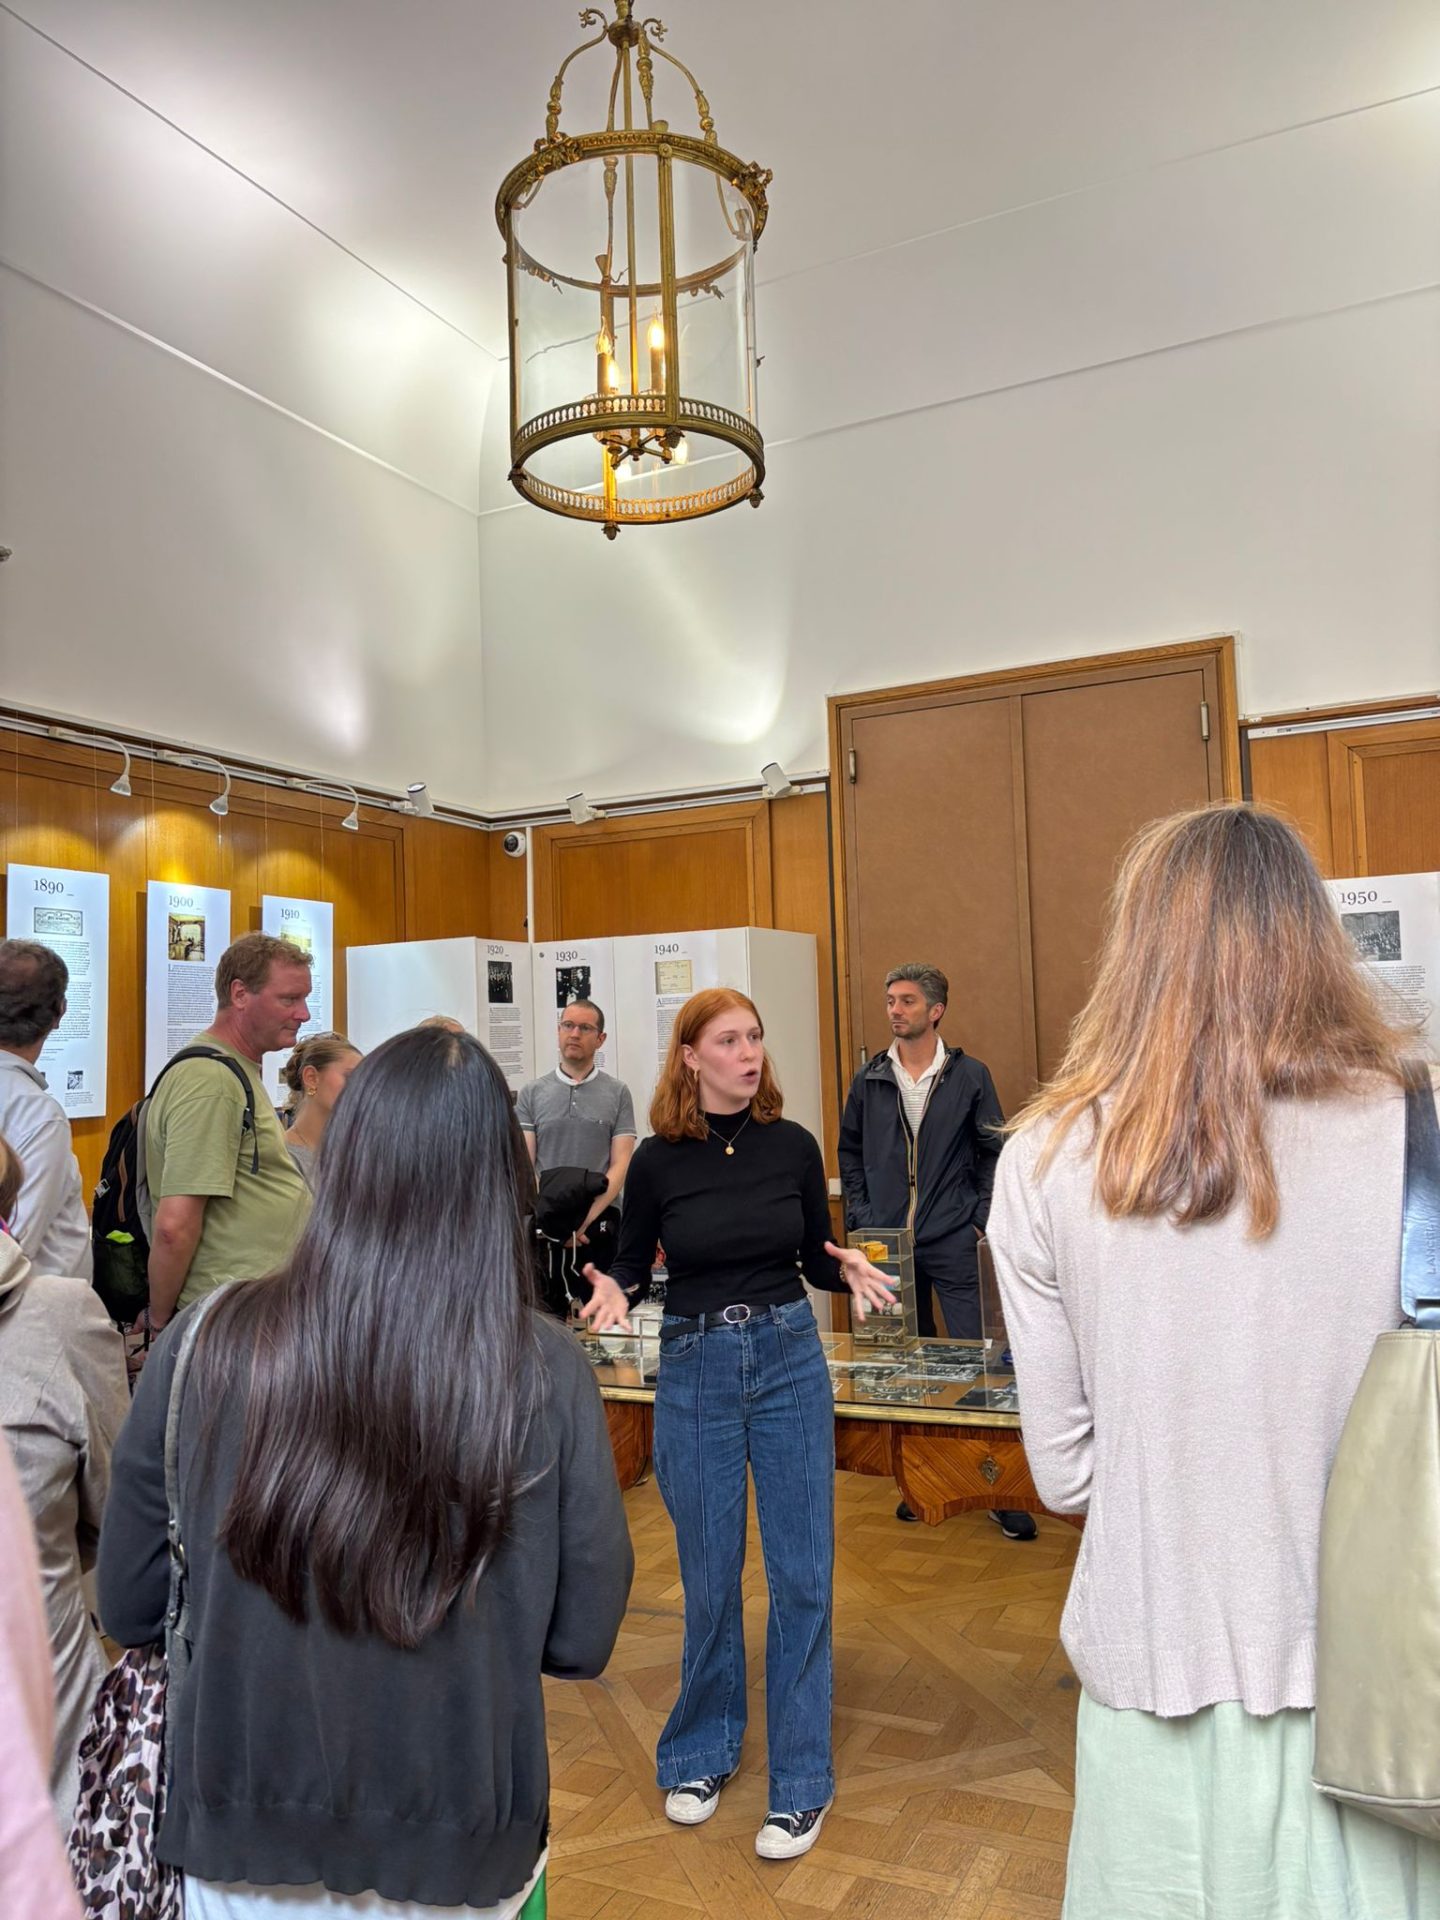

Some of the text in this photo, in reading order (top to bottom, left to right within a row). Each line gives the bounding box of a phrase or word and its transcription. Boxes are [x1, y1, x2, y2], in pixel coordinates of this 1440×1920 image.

[33, 878, 64, 894] 1890
[169, 895, 194, 908] 1900
[1340, 890, 1378, 905] 1950
[281, 908, 300, 920] 1910
[487, 944, 504, 956] 1920
[654, 943, 679, 955] 1940
[555, 951, 578, 962] 1930
